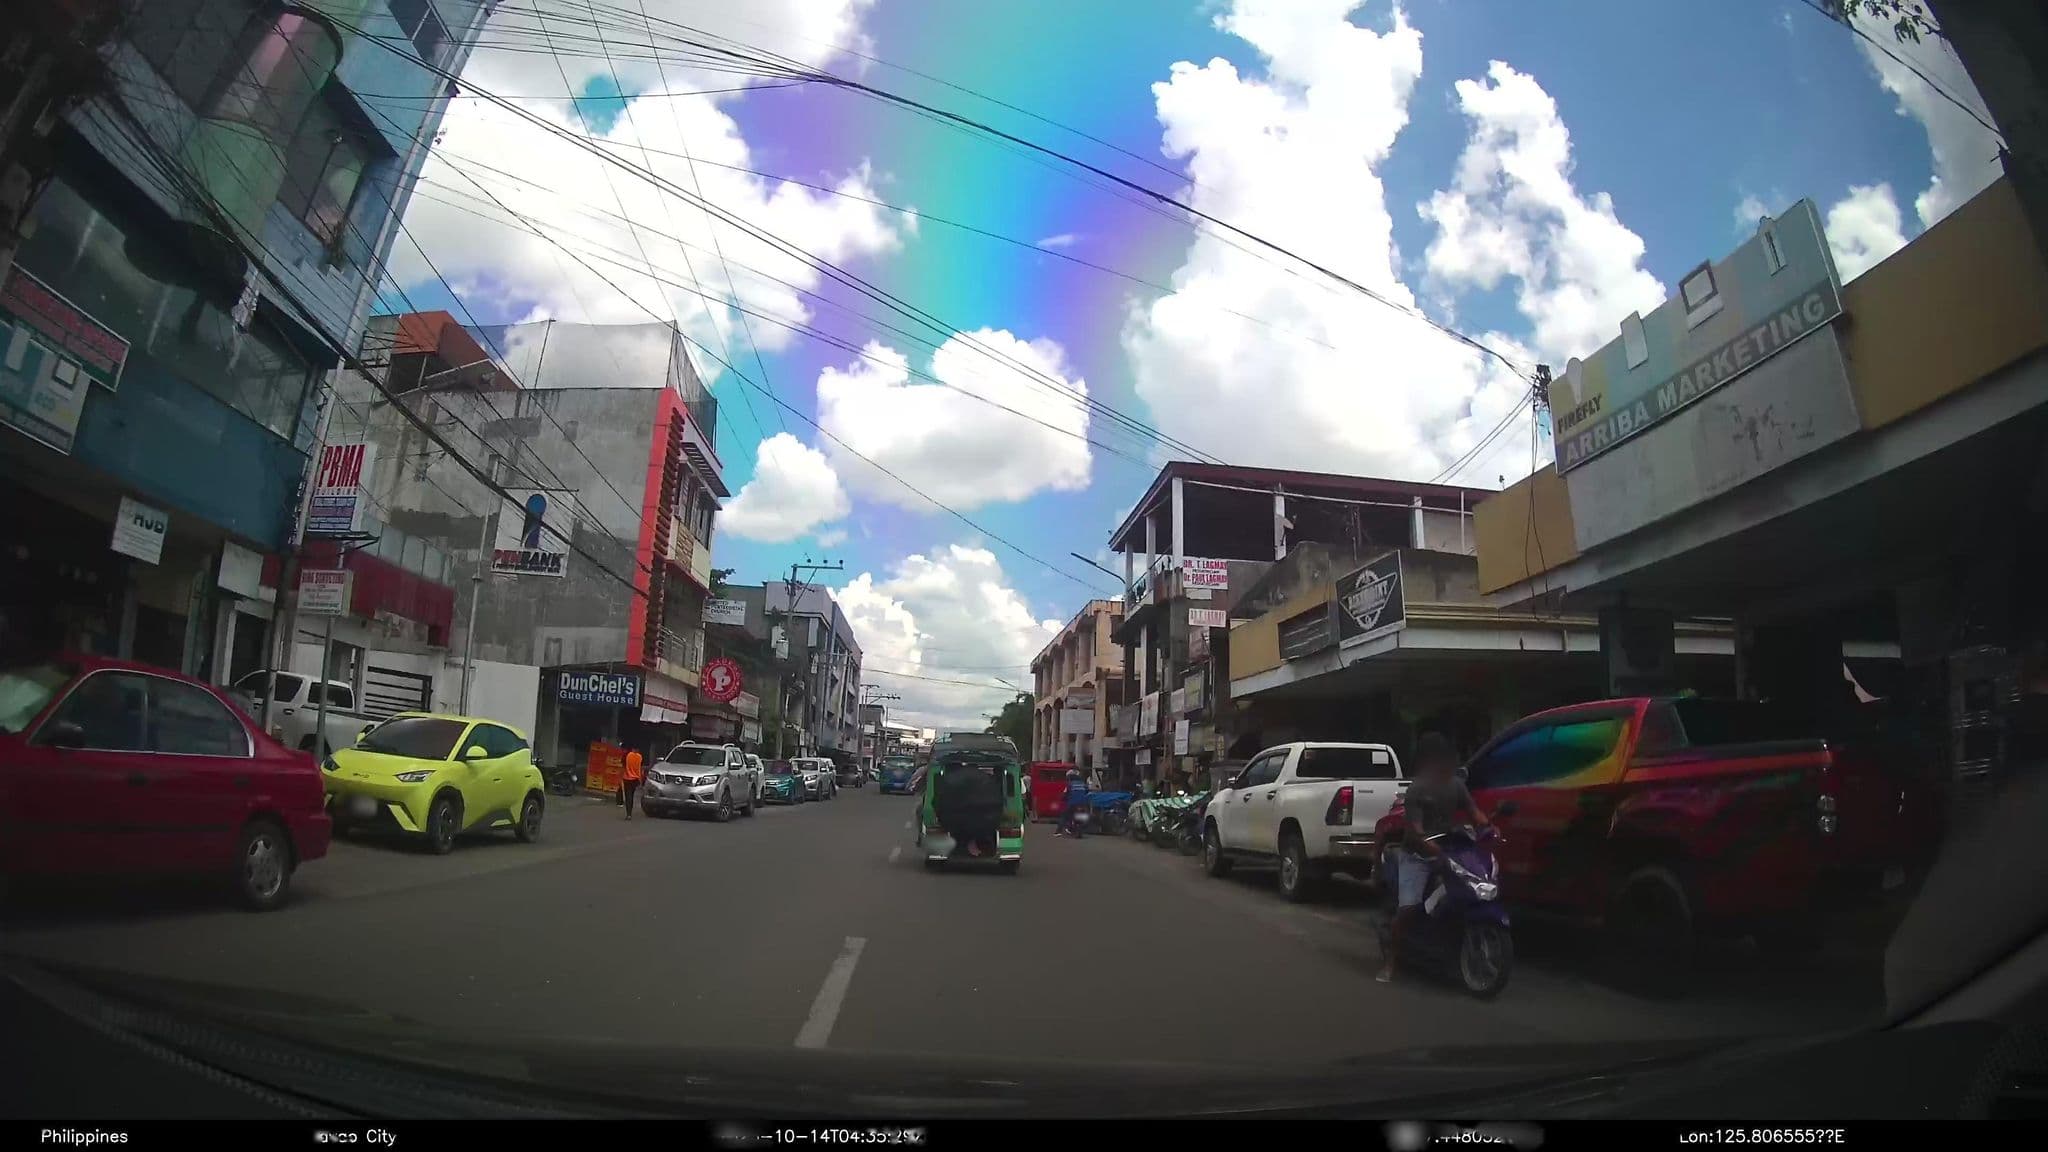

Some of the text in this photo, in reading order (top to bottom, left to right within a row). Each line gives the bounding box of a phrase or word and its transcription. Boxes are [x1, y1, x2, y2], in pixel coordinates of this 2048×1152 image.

[1566, 291, 1826, 465] ARRIBA MARKETING
[1558, 392, 1602, 433] FIREFLY
[318, 444, 365, 487] PBMA
[559, 690, 593, 702] Guest
[597, 692, 634, 705] House
[560, 672, 634, 695] DunChel's
